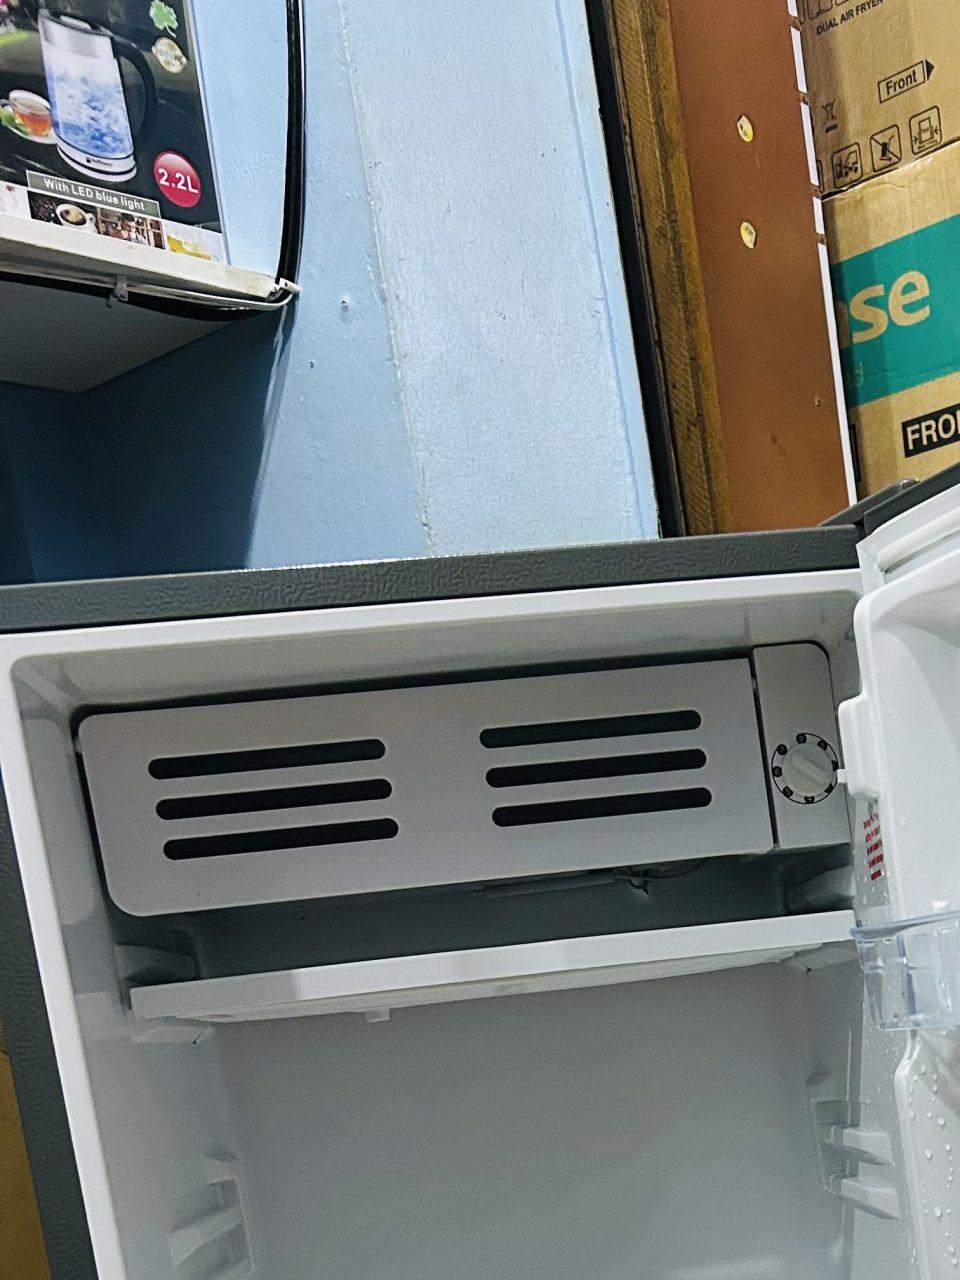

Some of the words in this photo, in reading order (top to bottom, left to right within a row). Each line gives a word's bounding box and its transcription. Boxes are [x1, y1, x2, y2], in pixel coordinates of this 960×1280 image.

[840, 9, 855, 24] AIR
[885, 69, 918, 96] Front
[157, 167, 199, 194] 2.2L
[43, 178, 70, 193] With
[71, 185, 94, 199] LED
[95, 190, 119, 206] blue
[120, 196, 146, 211] light
